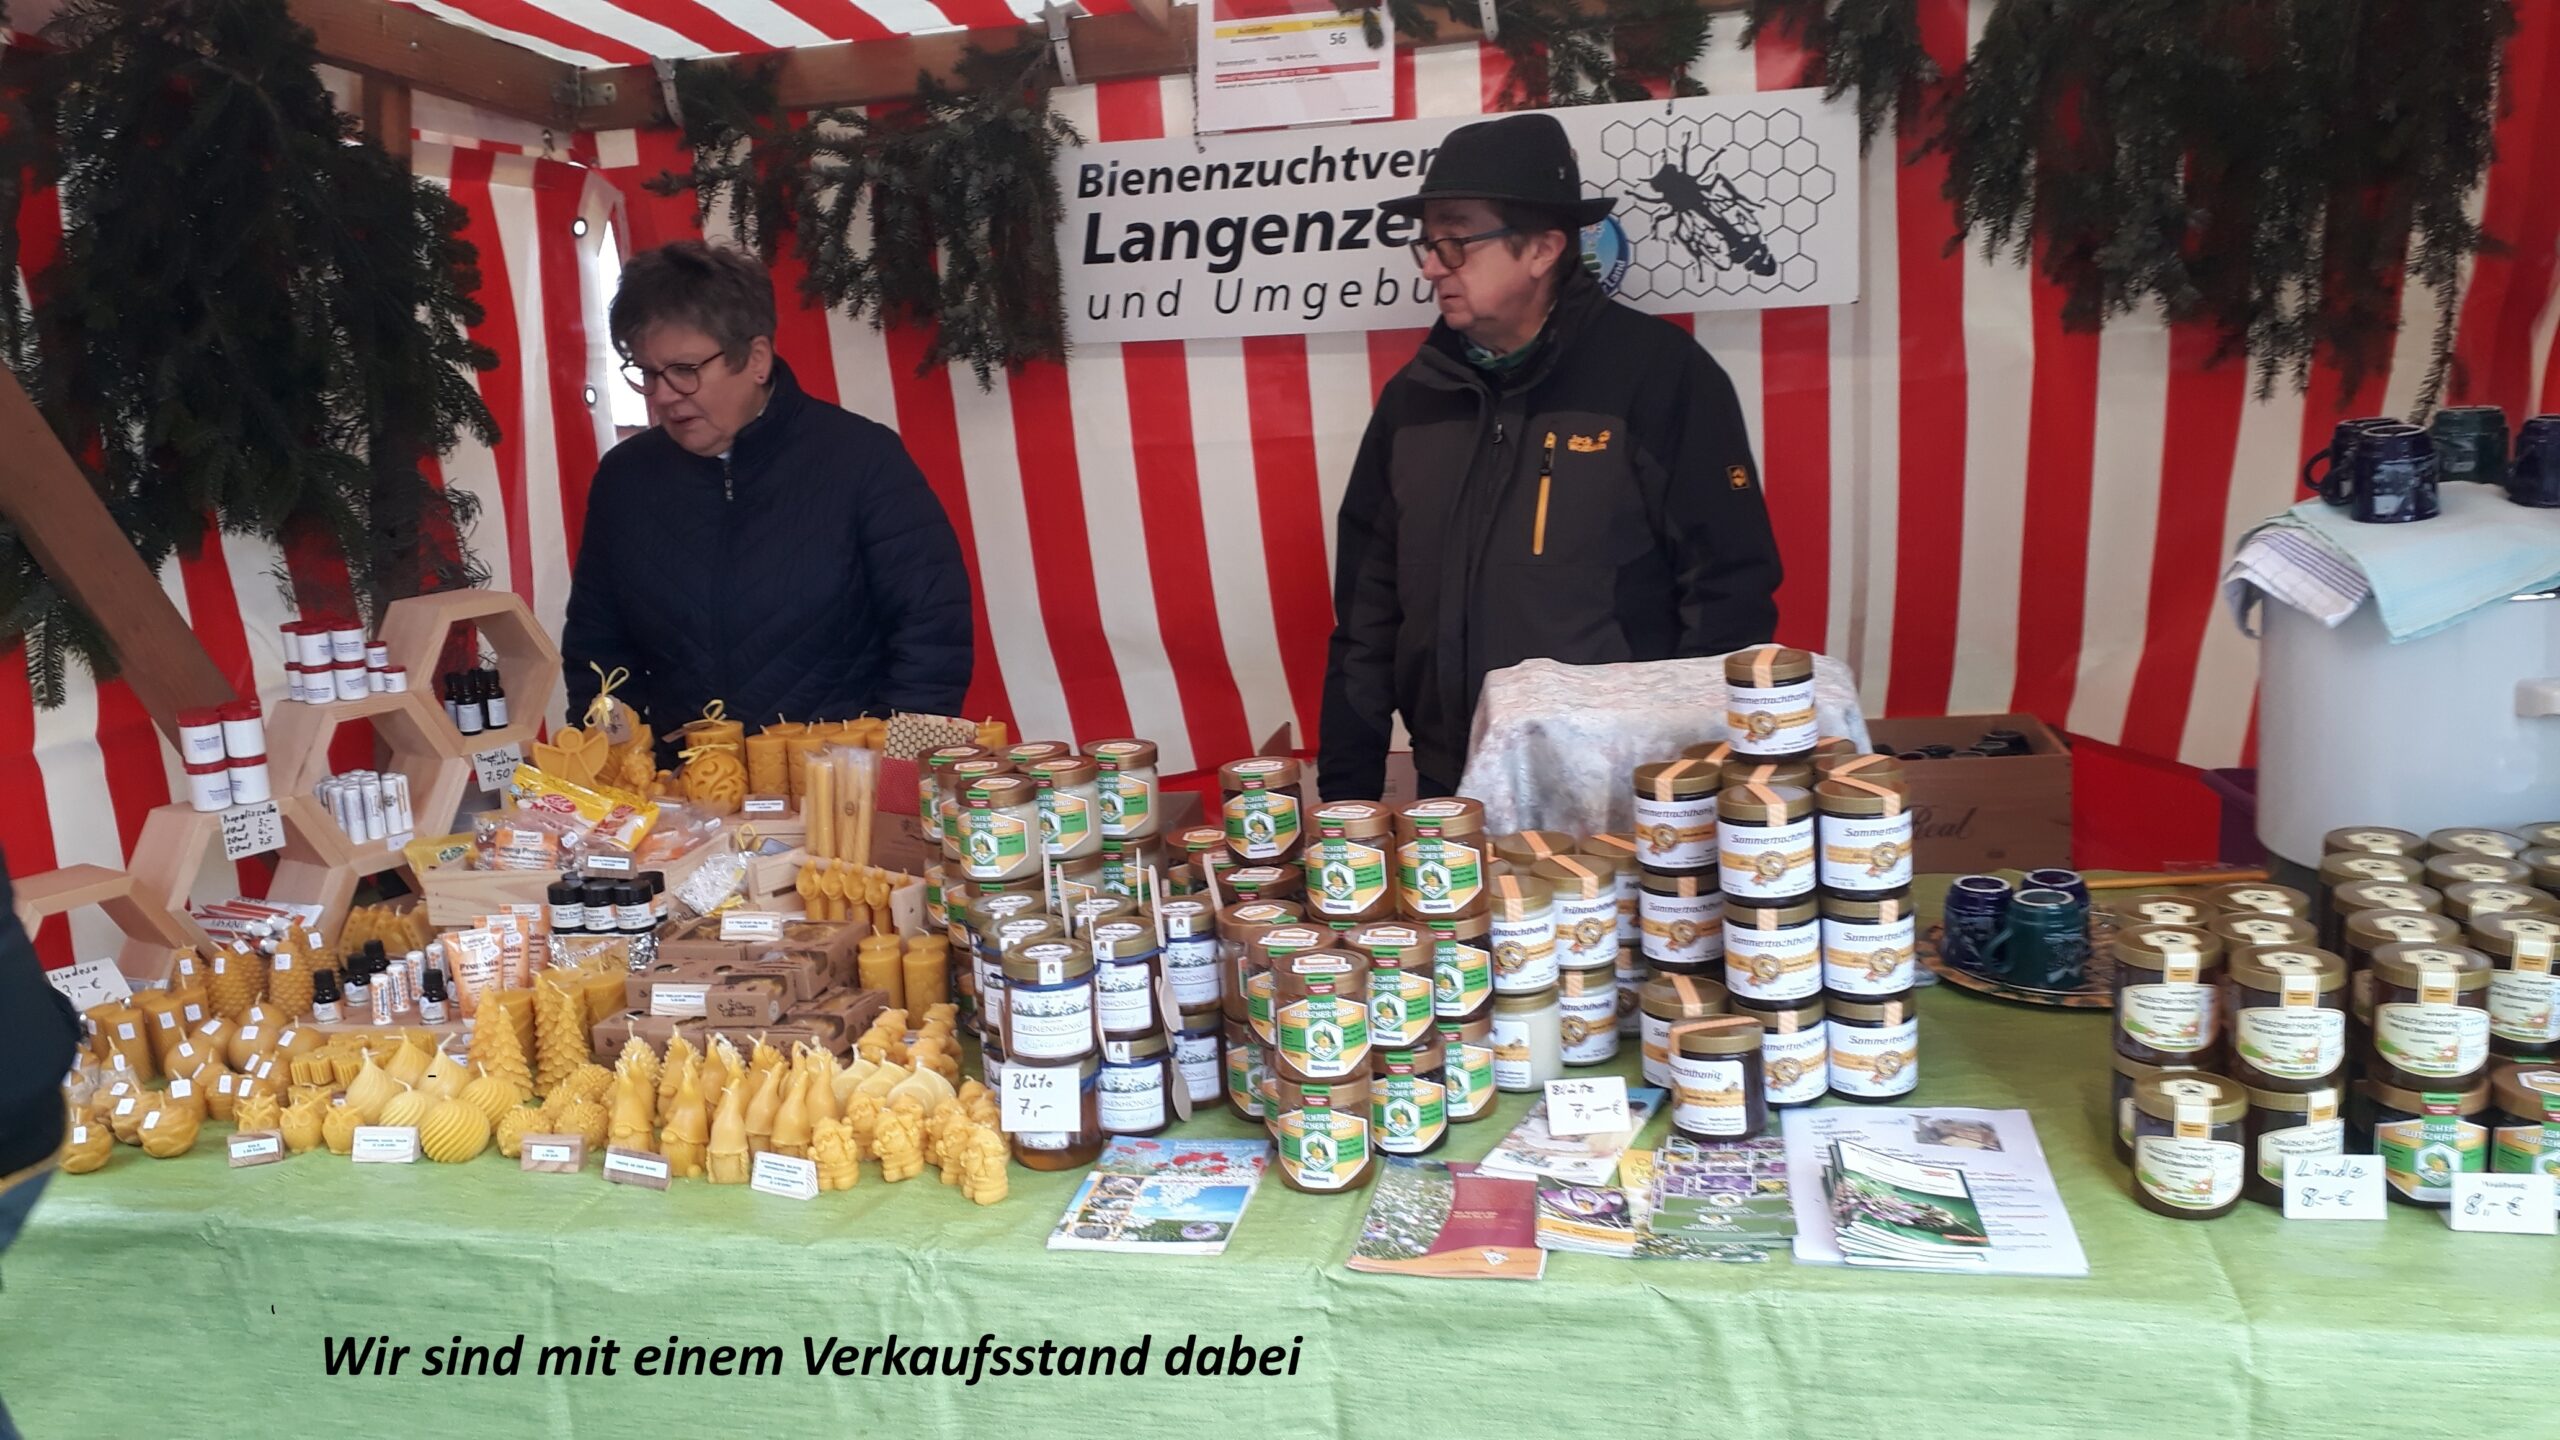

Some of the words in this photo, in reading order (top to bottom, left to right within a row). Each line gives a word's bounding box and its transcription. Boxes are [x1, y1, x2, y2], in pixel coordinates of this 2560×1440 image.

[1329, 32, 1347, 45] 56
[1088, 278, 1182, 321] und
[1214, 267, 1436, 320] Umgebu
[2295, 1159, 2368, 1179] Linde
